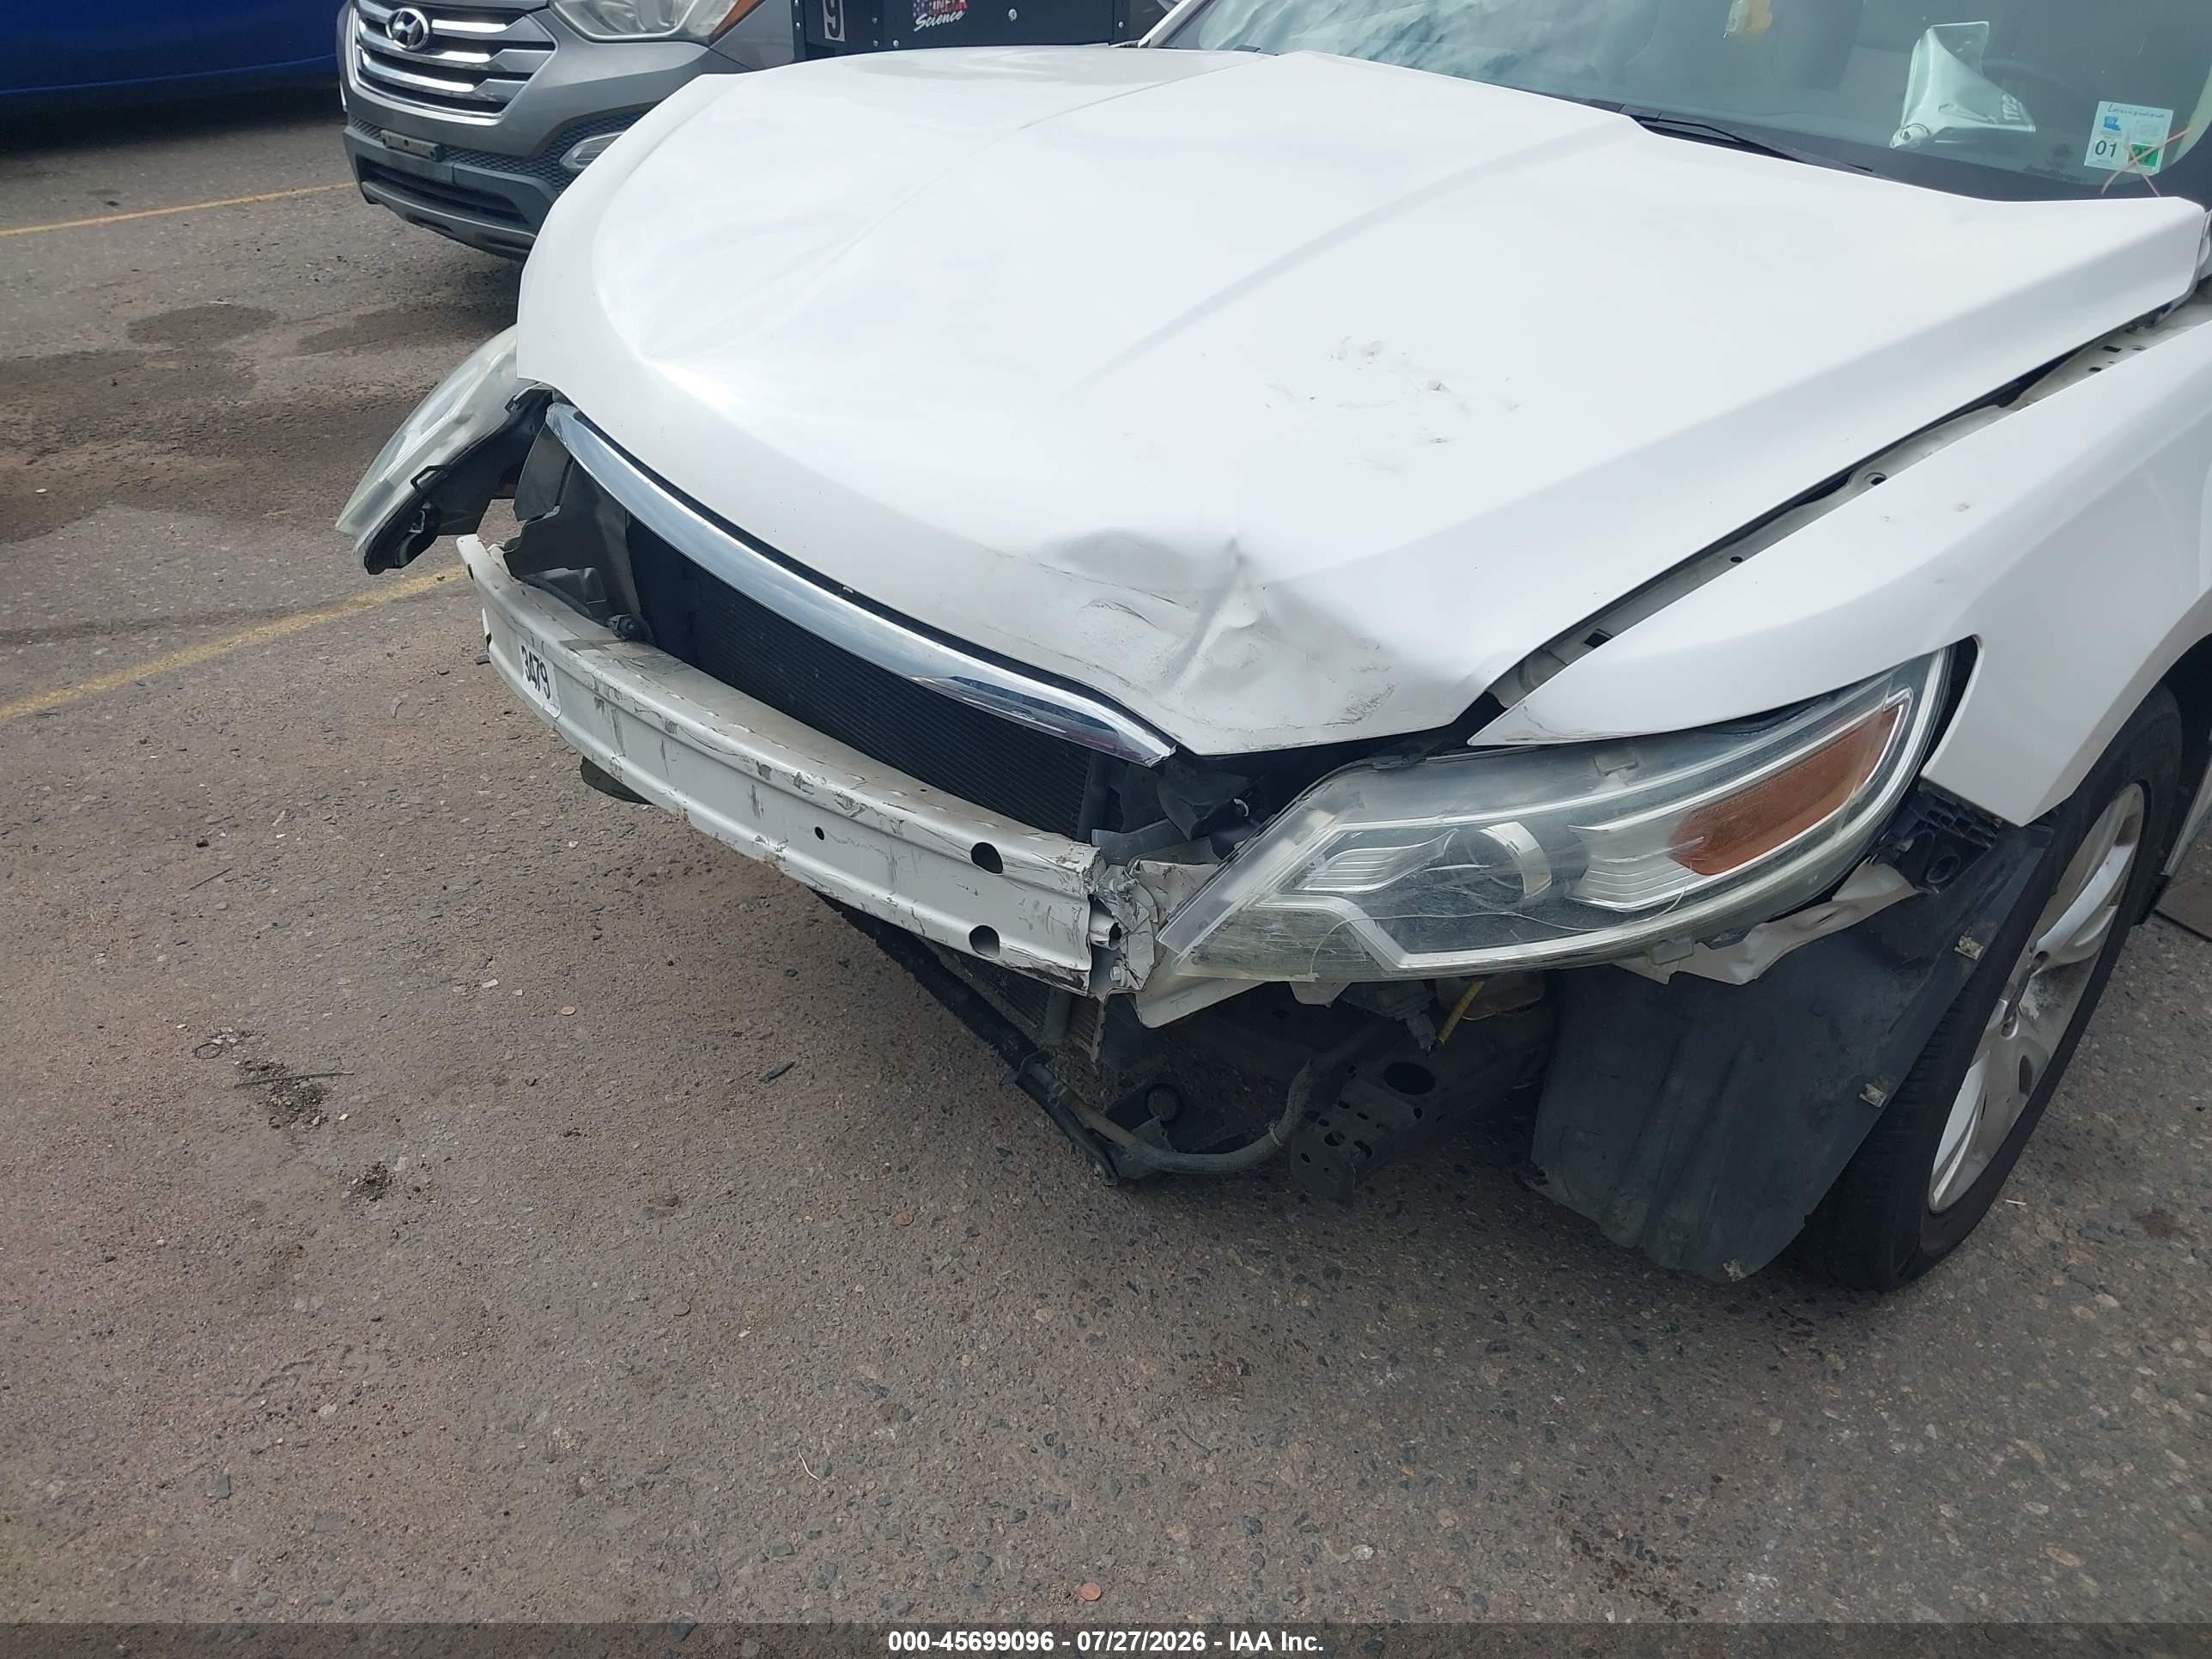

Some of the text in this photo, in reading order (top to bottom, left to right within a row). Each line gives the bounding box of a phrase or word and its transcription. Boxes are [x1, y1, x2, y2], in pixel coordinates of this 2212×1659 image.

[914, 10, 966, 33] Science
[2094, 140, 2118, 158] 01
[521, 646, 551, 700] 3479
